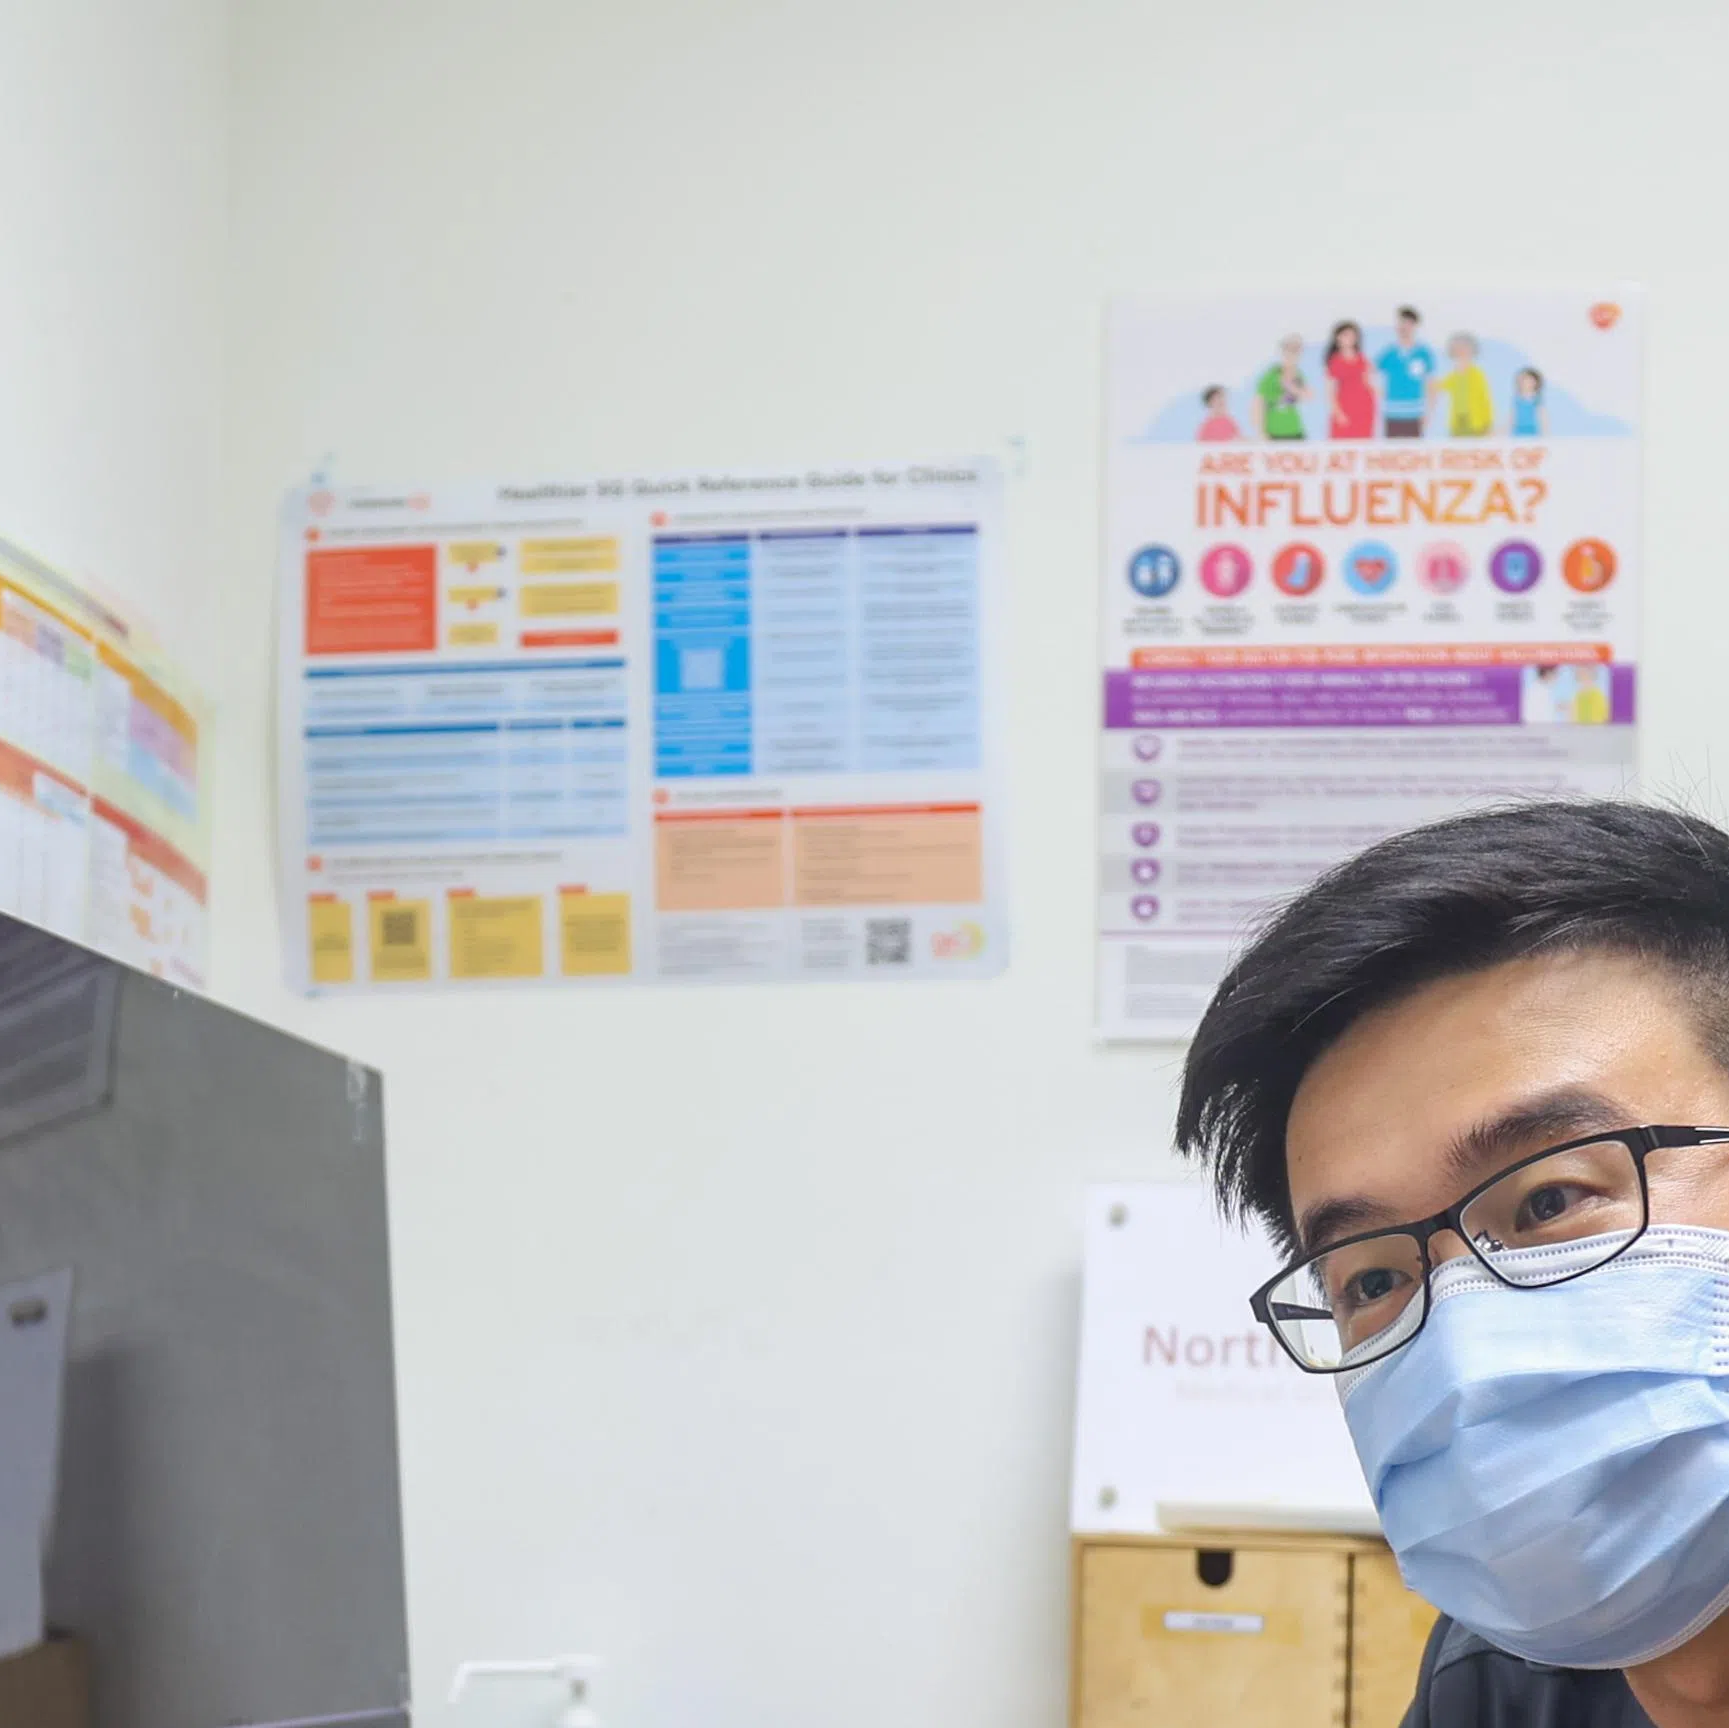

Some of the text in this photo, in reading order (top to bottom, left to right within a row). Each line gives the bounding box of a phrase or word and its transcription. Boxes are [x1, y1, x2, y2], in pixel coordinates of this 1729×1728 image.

[1199, 447, 1547, 475] ARE YOU AT HIGH RISK OF
[1194, 479, 1547, 528] INFLUENZA?
